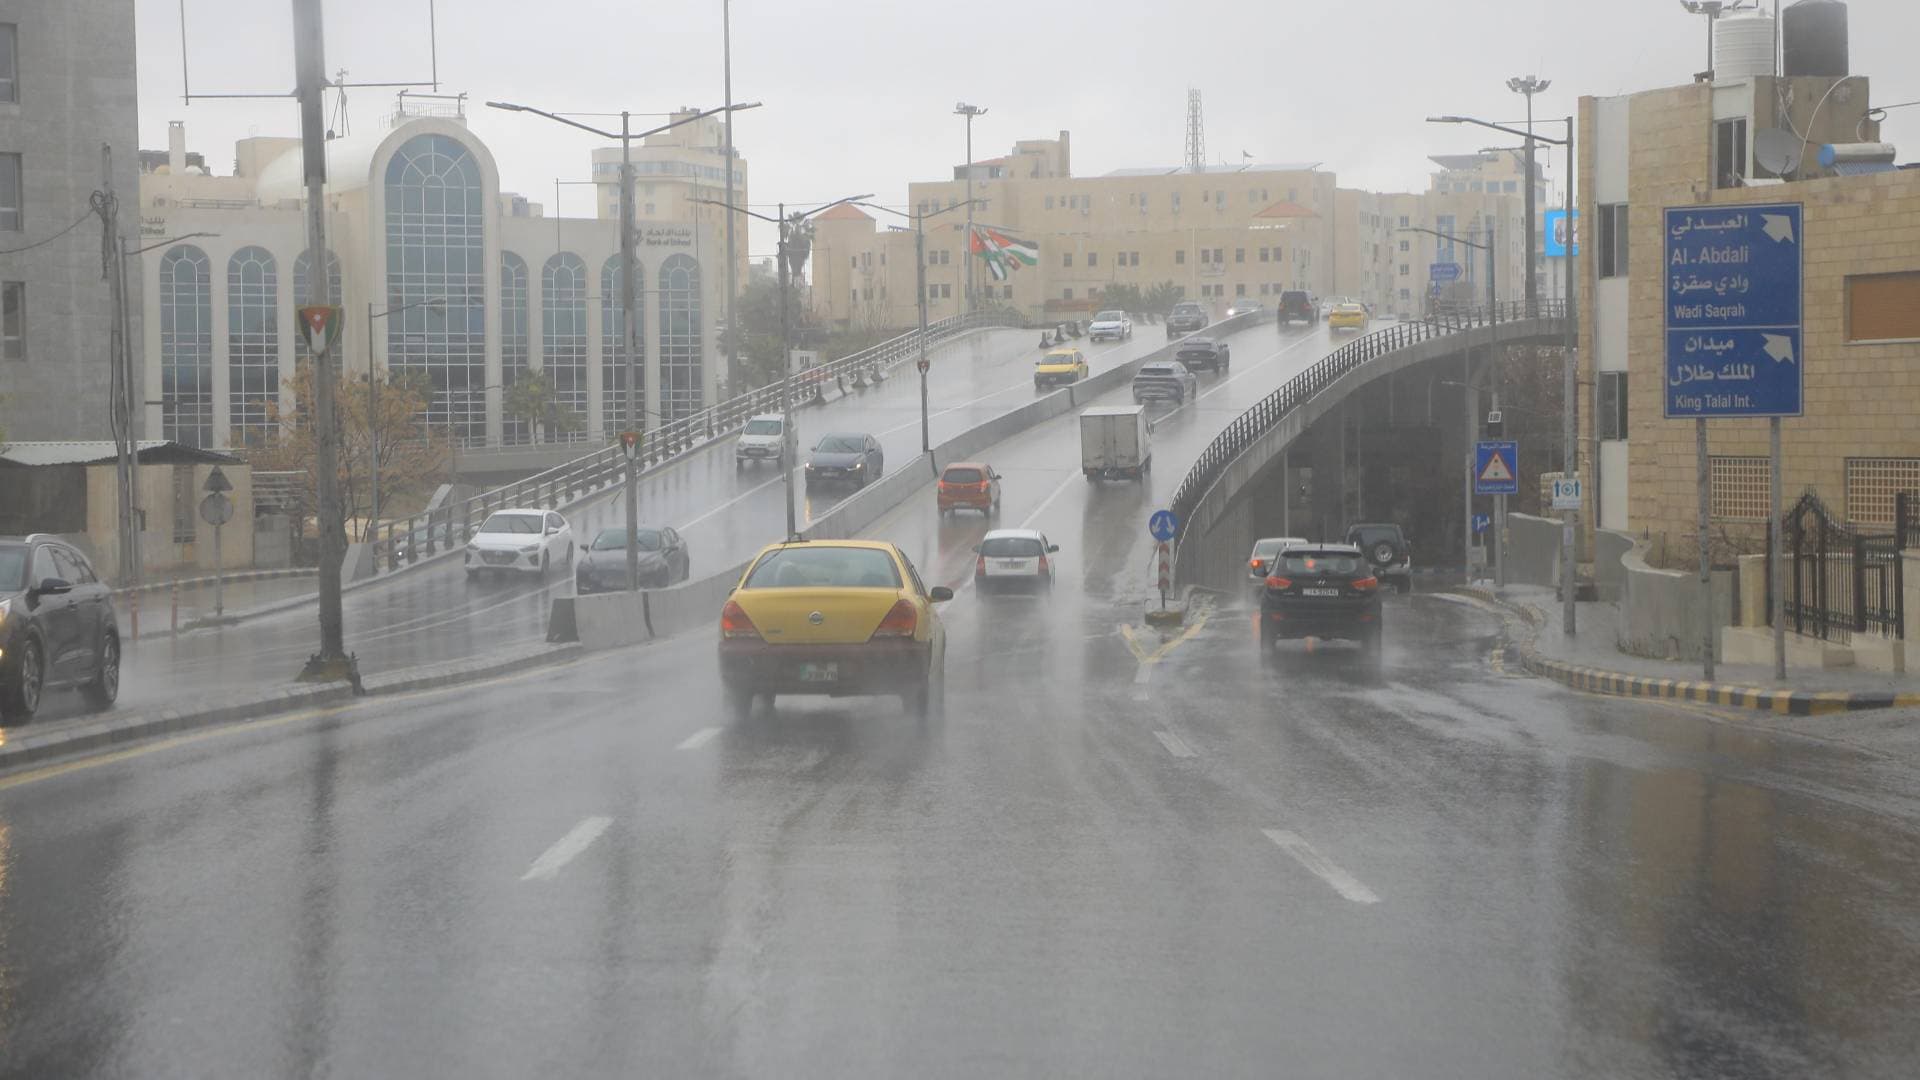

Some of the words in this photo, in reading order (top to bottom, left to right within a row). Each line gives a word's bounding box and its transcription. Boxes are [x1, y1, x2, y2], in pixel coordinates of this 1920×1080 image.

[1671, 214, 1749, 240] العبدلي
[1699, 246, 1749, 264] Abdali
[1714, 275, 1749, 295] وادي
[1674, 304, 1702, 318] Wadi
[1705, 303, 1745, 320] Saqrah
[1685, 336, 1734, 355] ميدان
[1670, 364, 1714, 386] طلال
[1717, 364, 1755, 379] الملك
[1675, 395, 1702, 411] King
[1705, 395, 1731, 408] Talal
